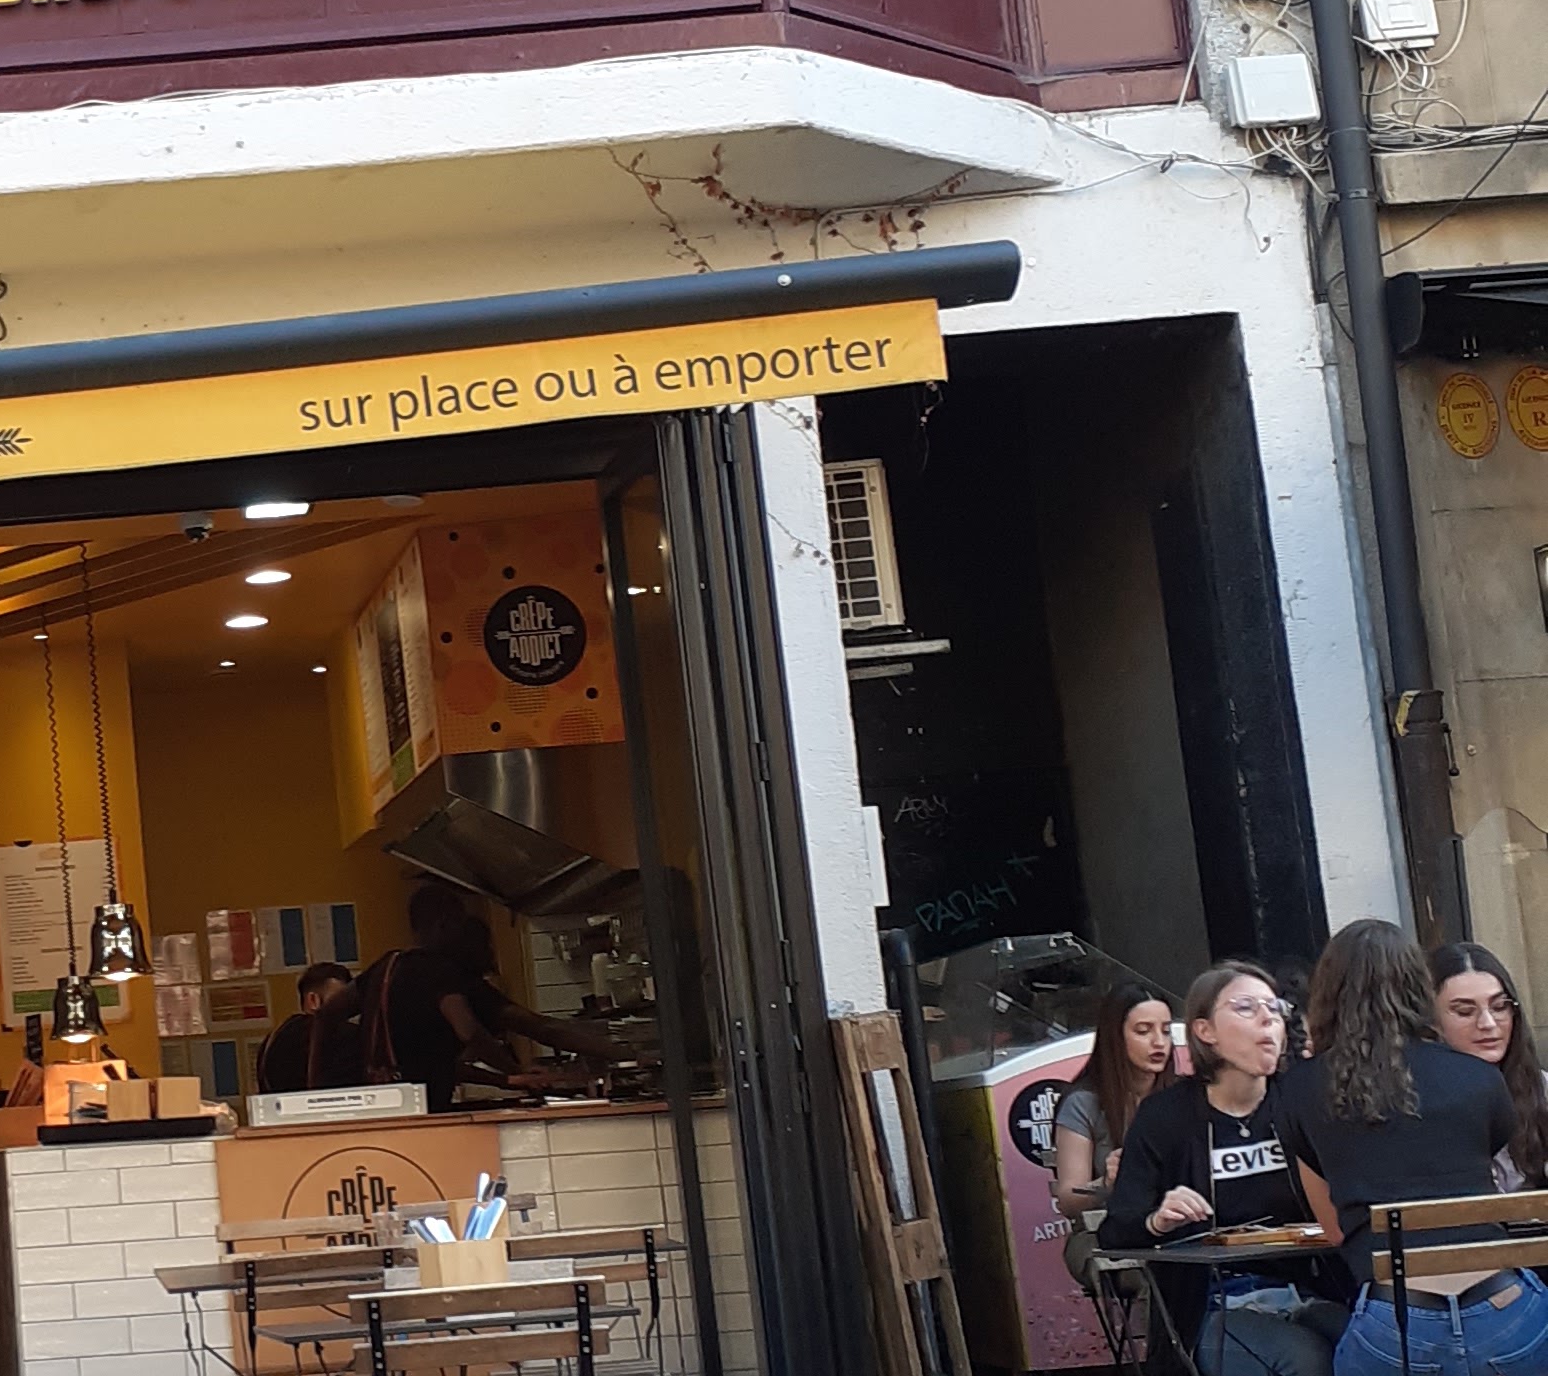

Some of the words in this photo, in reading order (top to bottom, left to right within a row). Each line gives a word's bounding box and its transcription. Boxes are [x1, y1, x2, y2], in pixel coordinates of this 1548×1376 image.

[300, 393, 372, 433] sur
[388, 375, 519, 433] place
[533, 366, 599, 408] ou
[613, 353, 640, 396] à
[655, 335, 893, 396] emporter
[509, 596, 555, 631] CRÊPE
[509, 634, 561, 666] ADDICT
[327, 1165, 399, 1224] CRÊPE
